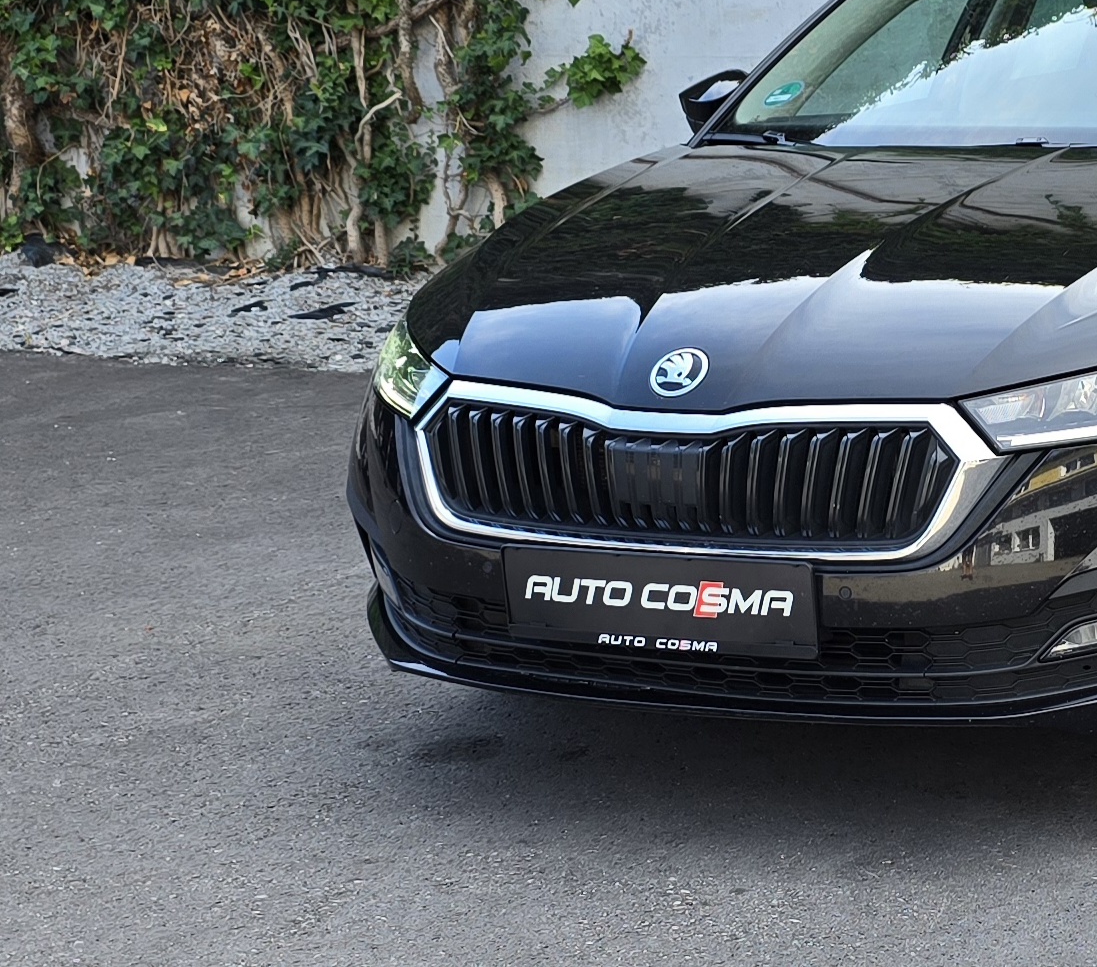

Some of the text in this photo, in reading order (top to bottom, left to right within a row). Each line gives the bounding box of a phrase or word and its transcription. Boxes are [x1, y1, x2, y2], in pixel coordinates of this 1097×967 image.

[525, 575, 794, 618] AUTO COSMA
[598, 634, 718, 653] AUTO COSMA
